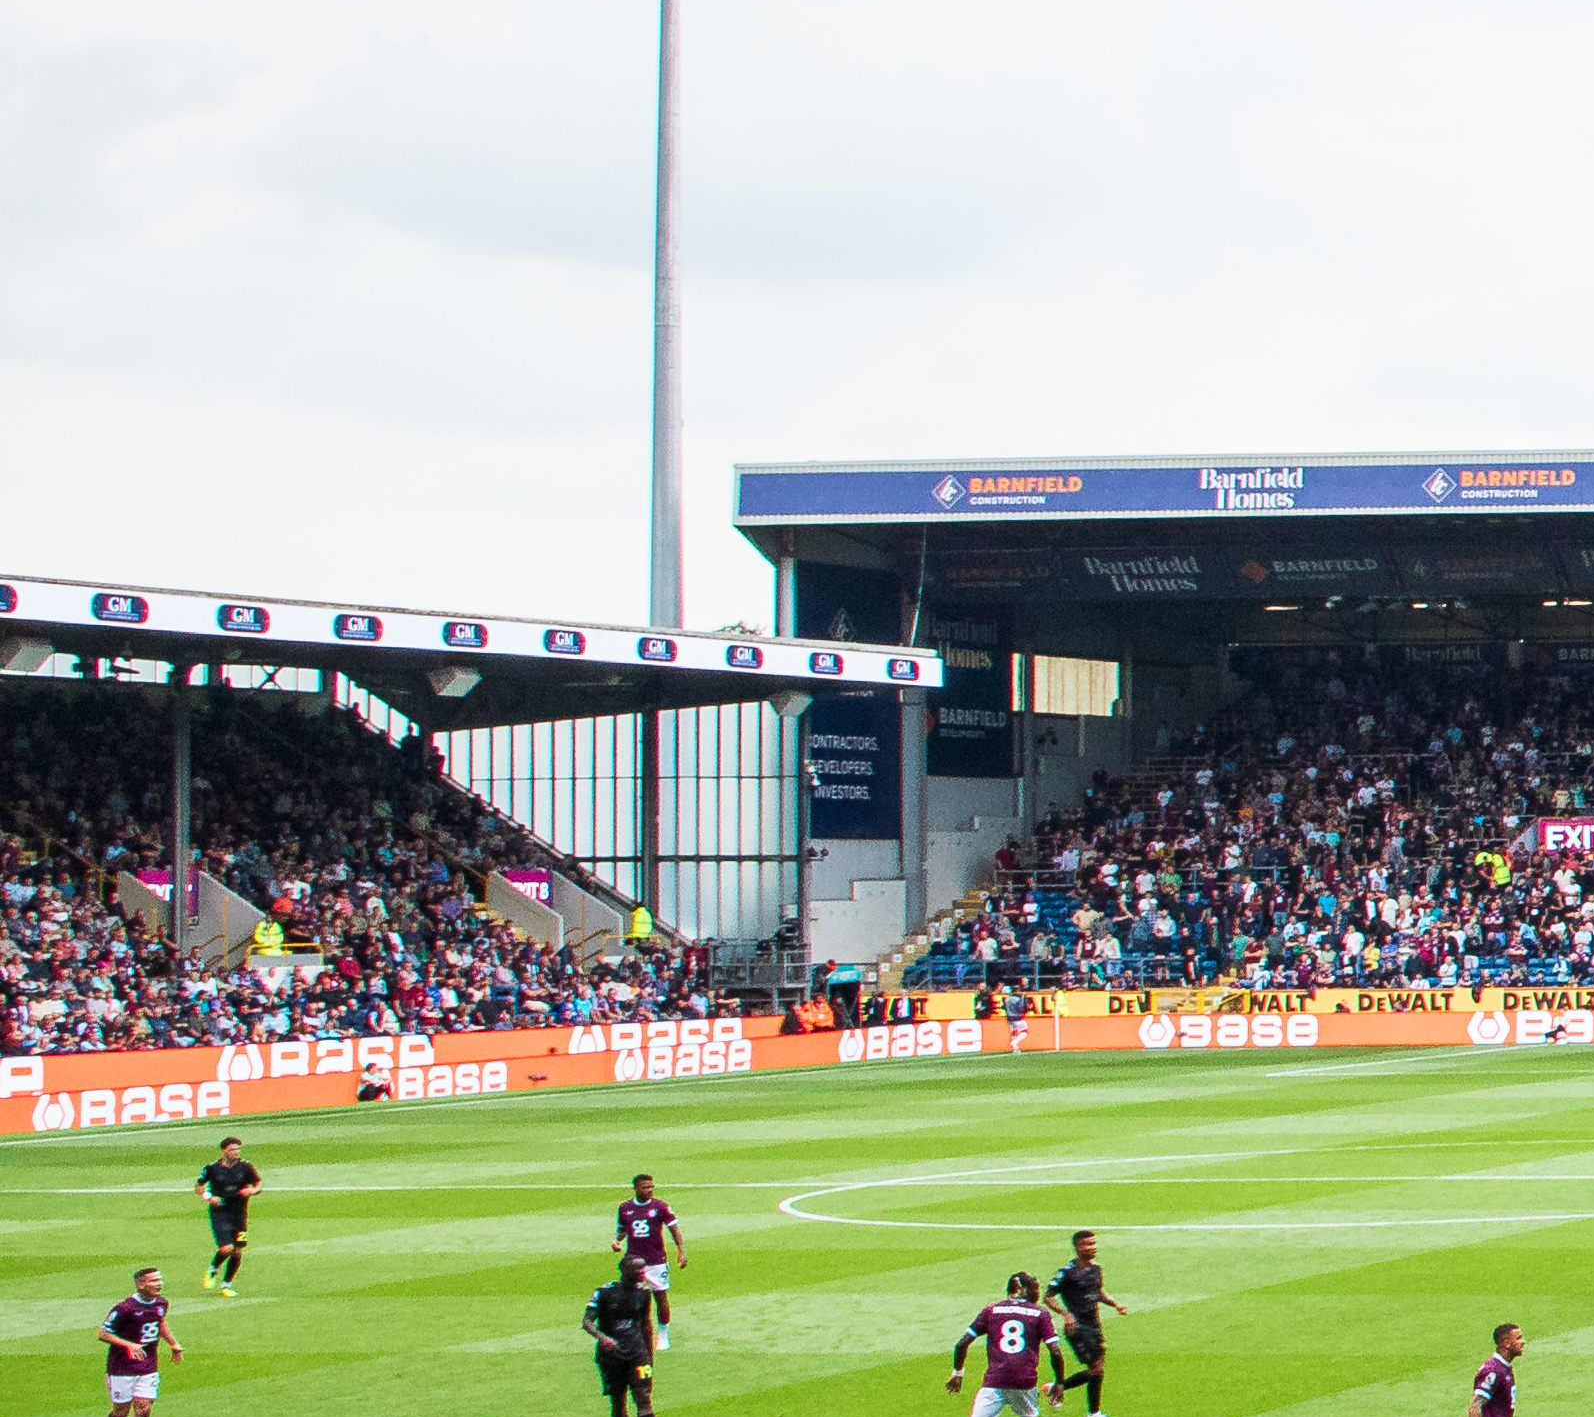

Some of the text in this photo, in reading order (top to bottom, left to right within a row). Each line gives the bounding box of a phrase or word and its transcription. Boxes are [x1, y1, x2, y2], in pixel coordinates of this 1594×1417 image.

[969, 476, 1082, 494] BARNFIELD
[1199, 467, 1304, 490] Barnfield
[1460, 470, 1576, 488] BARNFIELD
[970, 496, 1047, 506] CONSTRUCTION
[1215, 488, 1295, 509] Homes
[1461, 489, 1538, 499] CONSTRUCTION
[1083, 555, 1203, 577] Barnfield
[1272, 557, 1379, 573] BARNFIELD
[1110, 575, 1199, 593] Homes
[108, 597, 133, 613] GM
[232, 607, 254, 624] GM
[347, 617, 368, 632] GM
[455, 624, 476, 639] GM
[556, 632, 575, 647] GM
[939, 706, 1007, 728] BARNFIELD
[808, 759, 875, 776] EVELOPERS.
[998, 1319, 1026, 1354] 8
